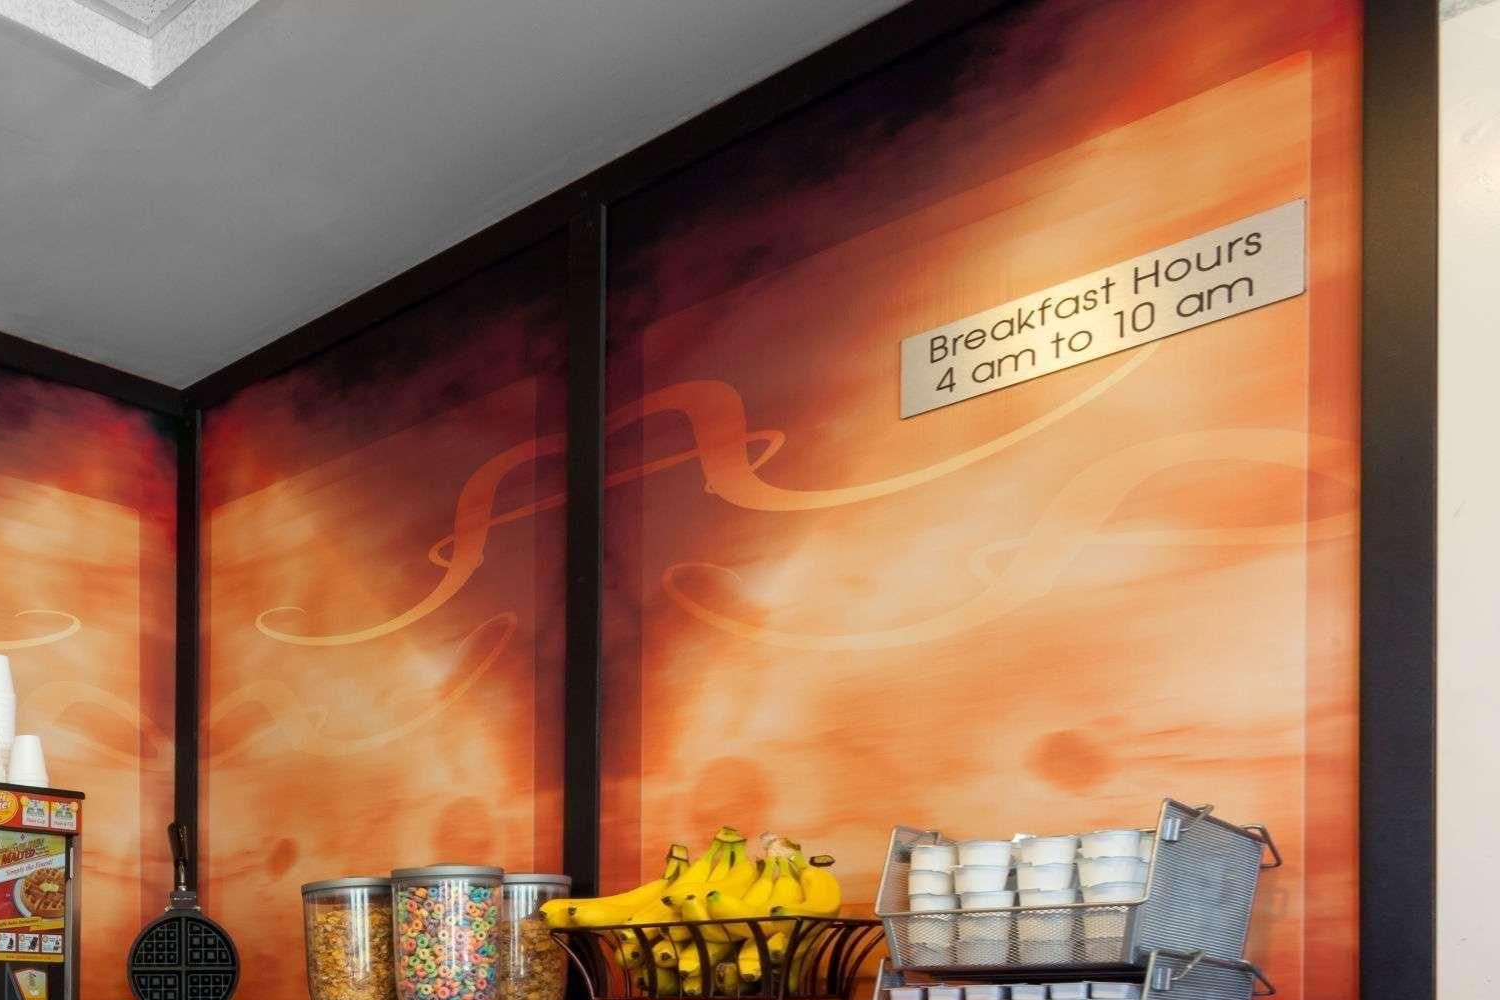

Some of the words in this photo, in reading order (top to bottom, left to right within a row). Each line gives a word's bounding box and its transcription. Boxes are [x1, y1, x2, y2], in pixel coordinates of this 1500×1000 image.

[929, 276, 1116, 363] Breakfast
[1133, 231, 1263, 294] Hours
[936, 365, 956, 393] 4
[971, 347, 1036, 385] am
[1050, 331, 1093, 359] to
[1112, 301, 1156, 338] 10
[1175, 276, 1254, 318] am
